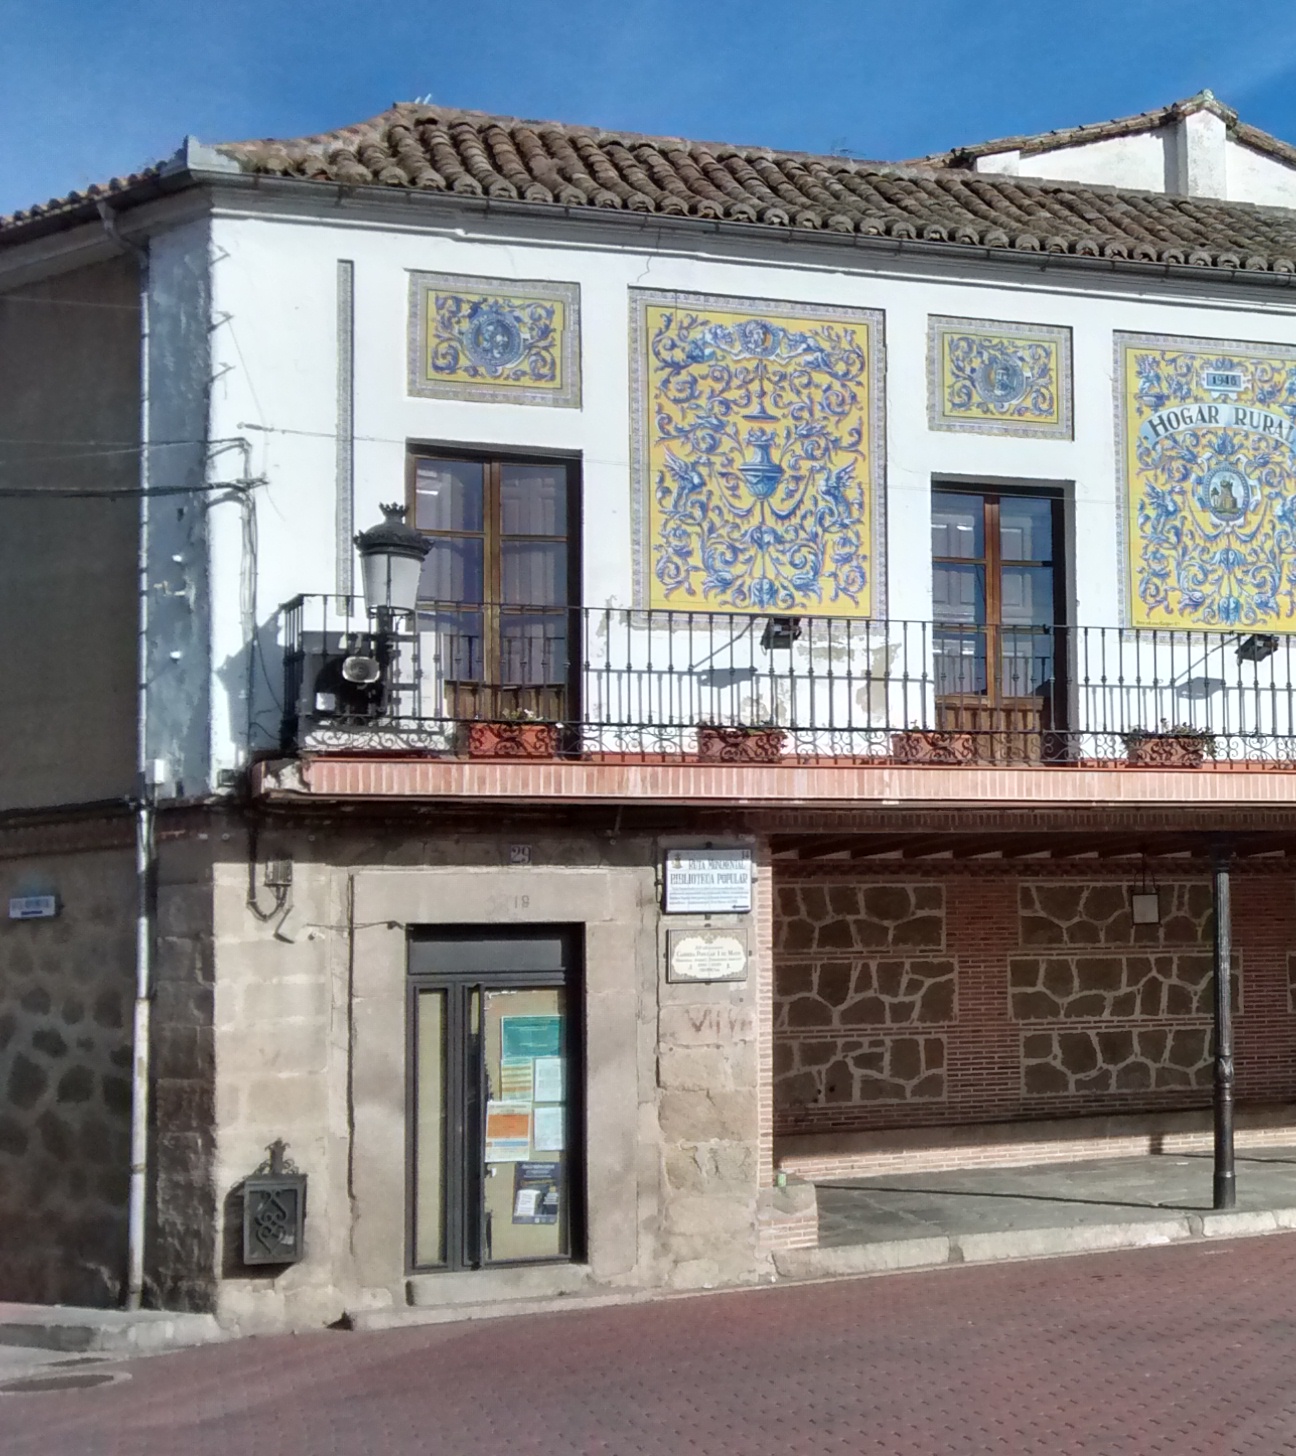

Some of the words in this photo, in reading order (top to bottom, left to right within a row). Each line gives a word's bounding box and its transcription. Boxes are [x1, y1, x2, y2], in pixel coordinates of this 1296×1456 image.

[1149, 405, 1220, 438] HOGAR
[1234, 408, 1296, 445] RURAL
[510, 846, 532, 864] 29
[670, 873, 715, 885] BIBLIOTECA
[717, 872, 748, 885] POPULAR
